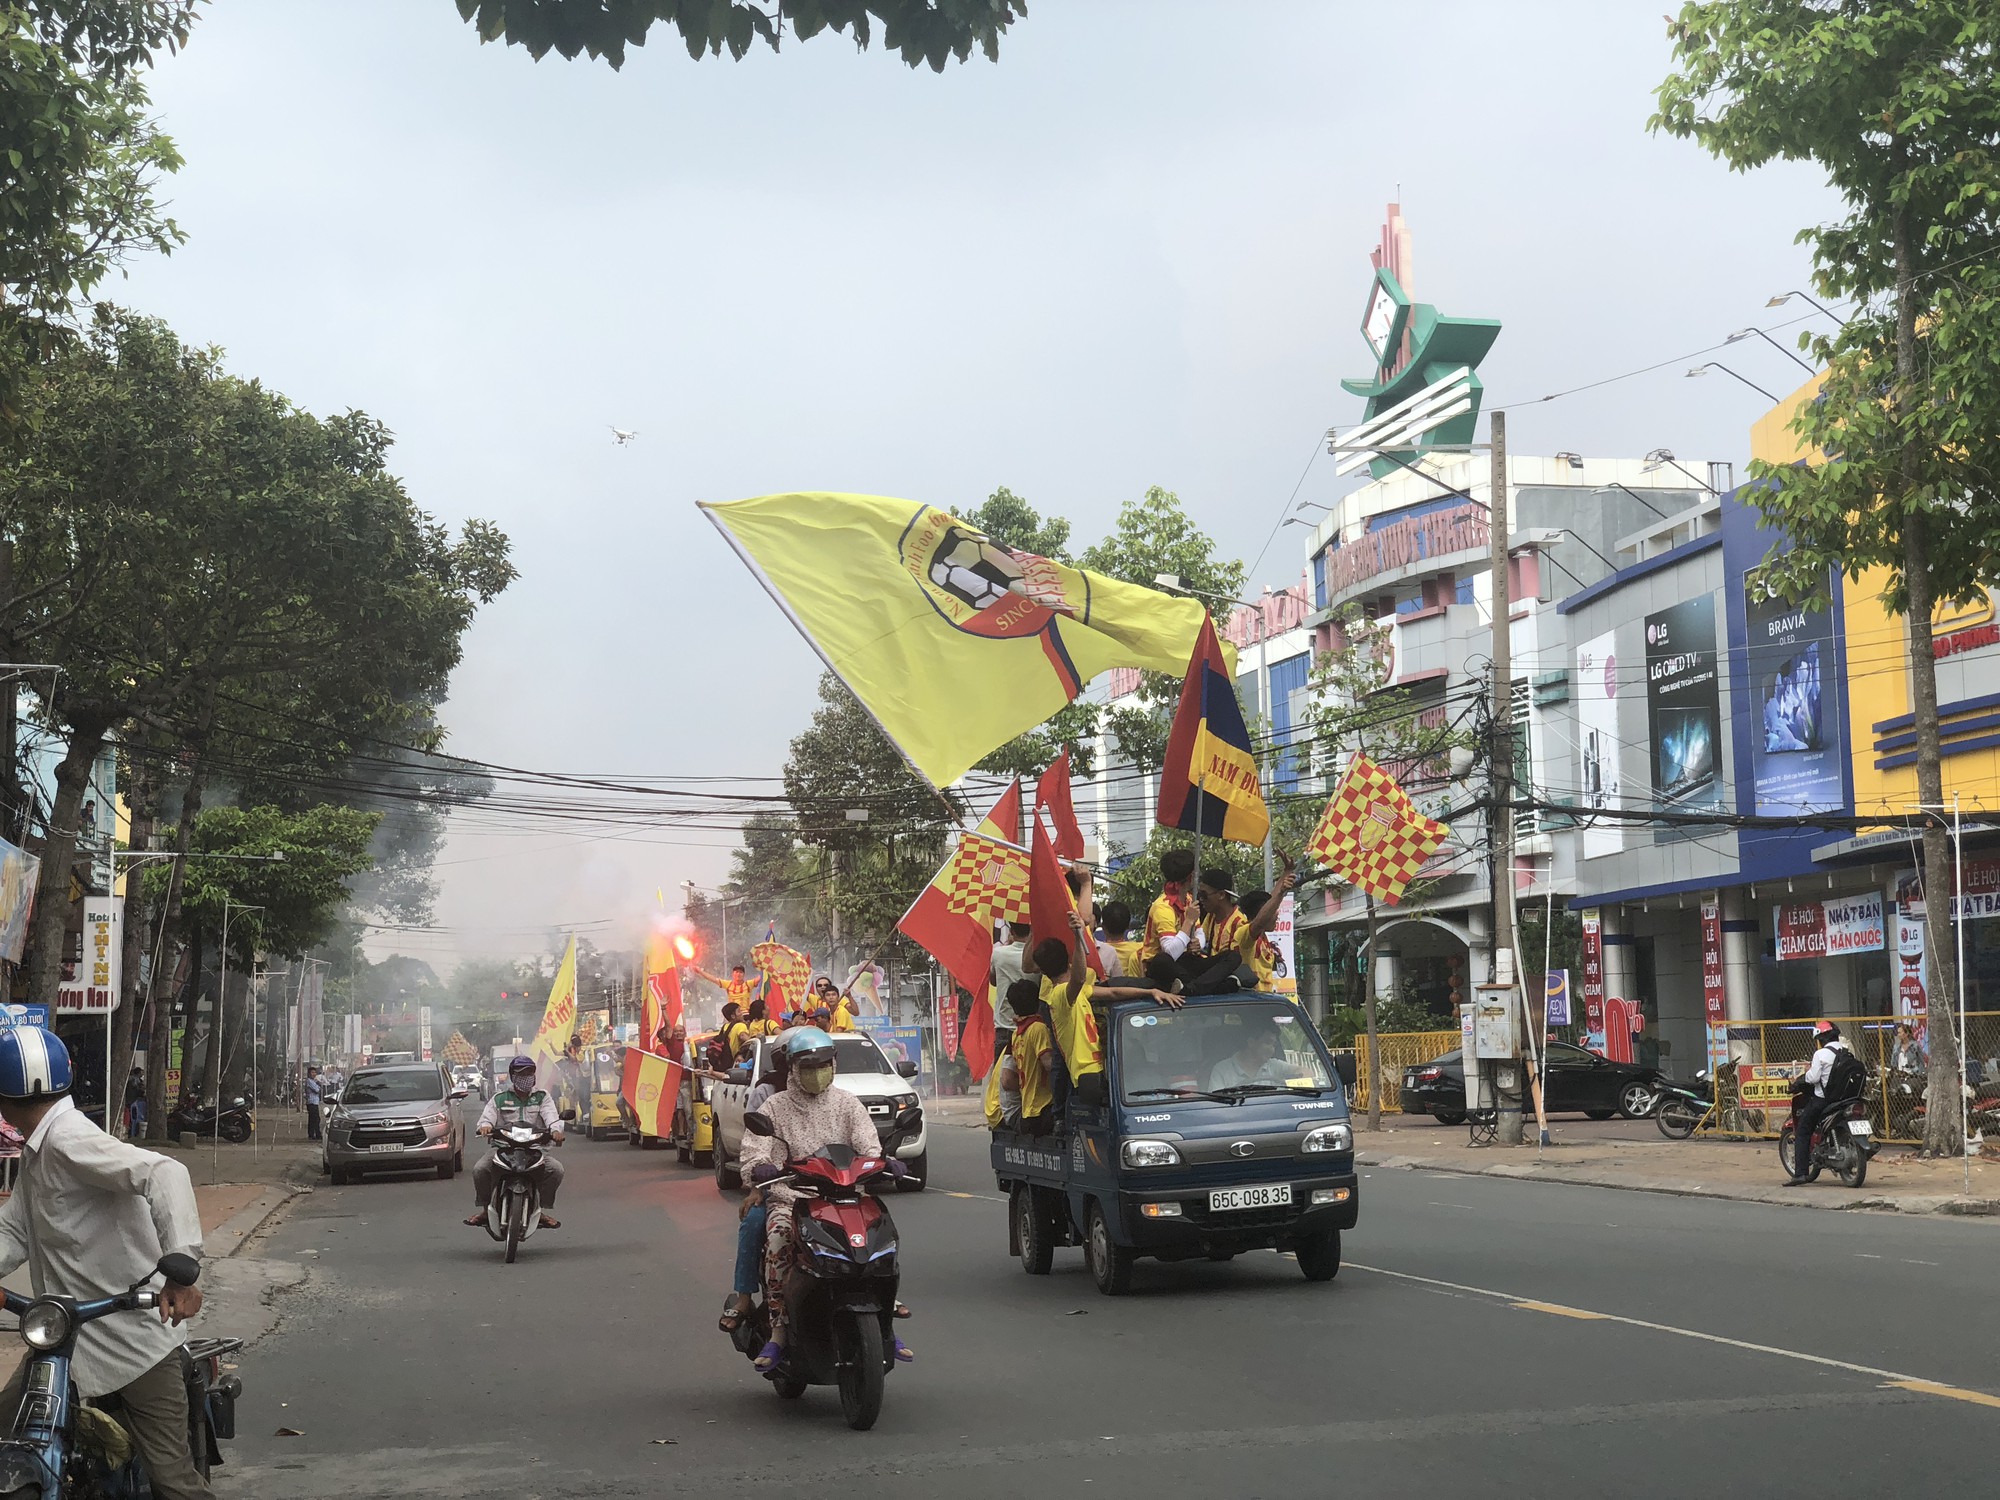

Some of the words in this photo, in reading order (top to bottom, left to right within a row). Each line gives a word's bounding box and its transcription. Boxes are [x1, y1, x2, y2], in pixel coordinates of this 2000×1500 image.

[1657, 623, 1667, 639] LG
[1768, 613, 1806, 636] BRAVIA
[1779, 634, 1796, 646] OLED
[1650, 663, 1662, 680] LG
[1685, 651, 1697, 669] TV
[1208, 753, 1240, 785] NAM
[1828, 903, 1859, 929] NHẬT
[1858, 897, 1881, 920] BẢN
[1780, 930, 1806, 954] GIẢM
[1807, 928, 1826, 951] GIÁ
[1853, 921, 1882, 947] QUỐC
[1909, 929, 1918, 941] LG
[1708, 994, 1720, 1011] GIÁ
[1292, 1101, 1334, 1111] TOWNER
[1134, 1113, 1171, 1123] THACO
[1212, 1186, 1290, 1209] 65C-098.35
